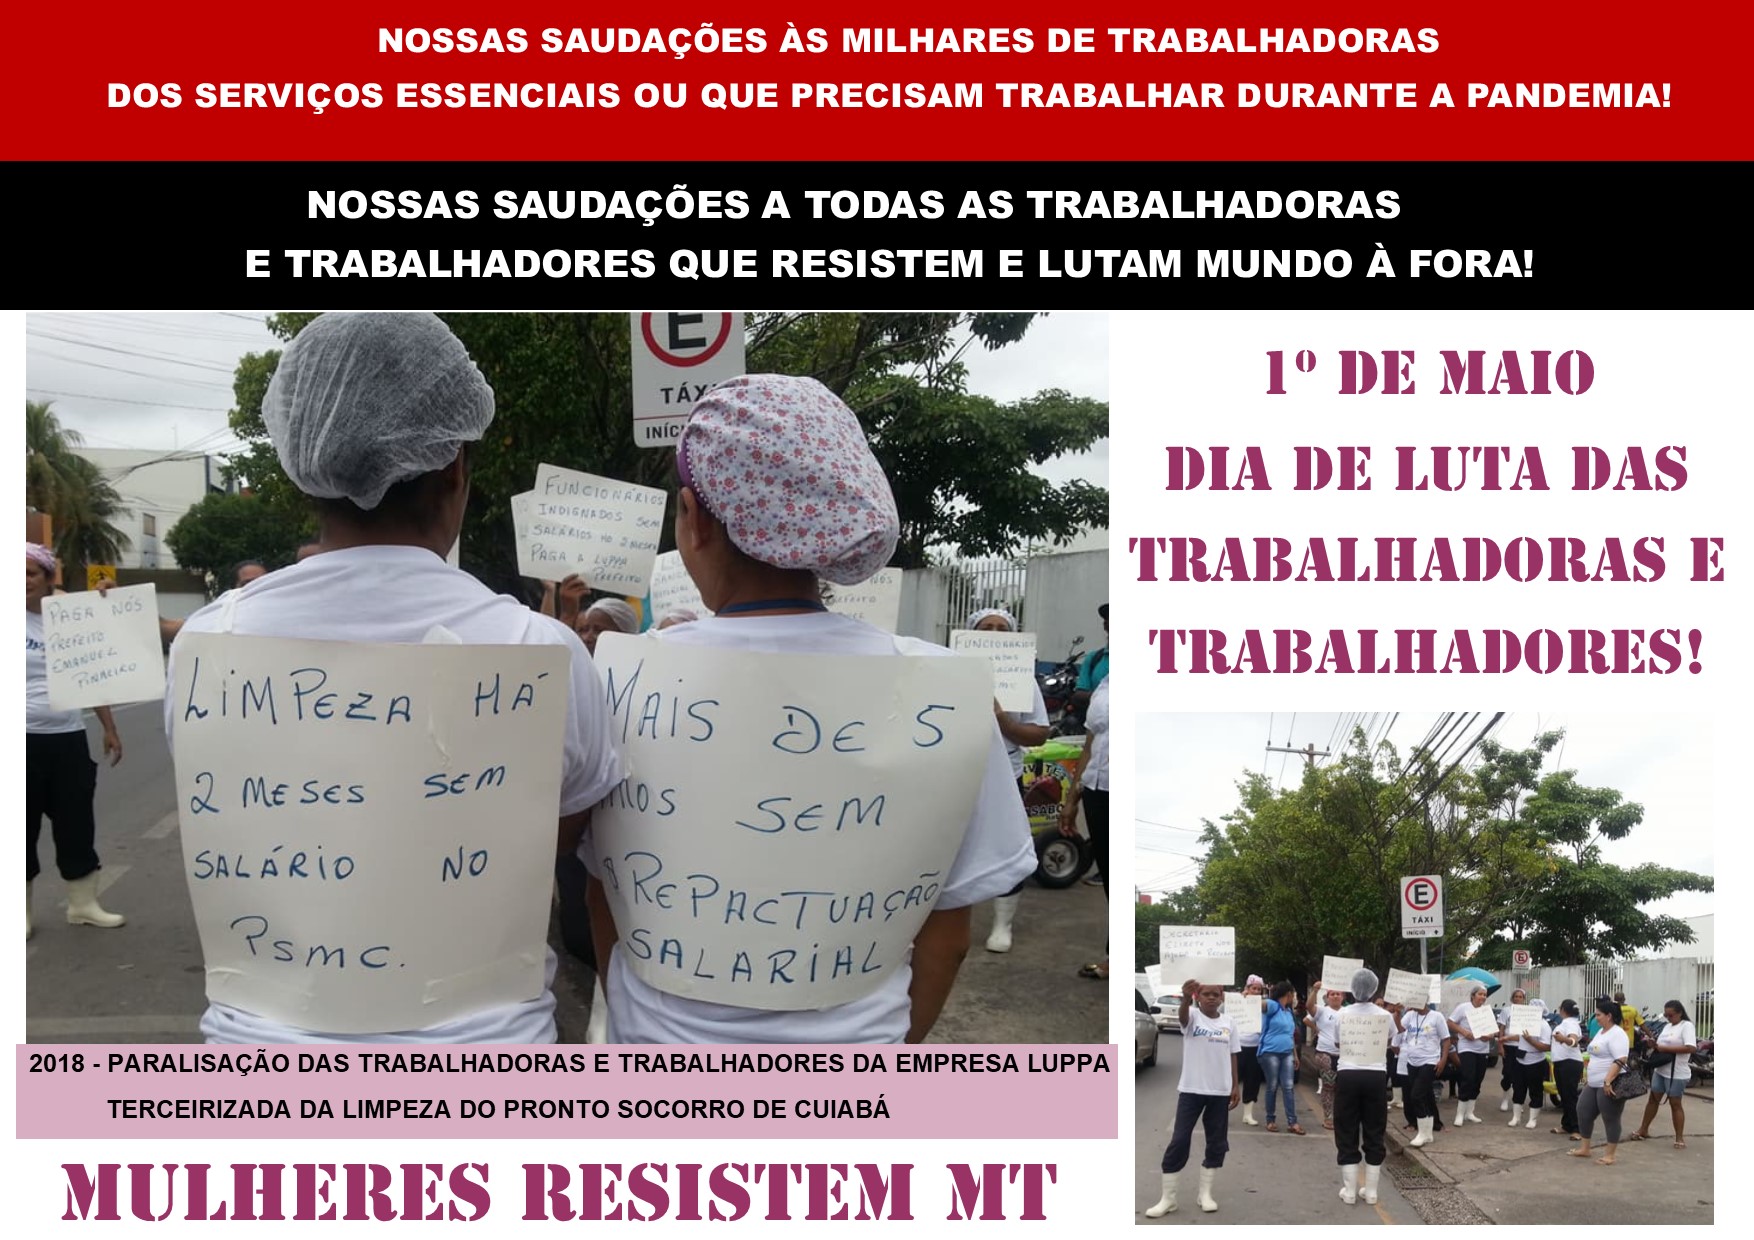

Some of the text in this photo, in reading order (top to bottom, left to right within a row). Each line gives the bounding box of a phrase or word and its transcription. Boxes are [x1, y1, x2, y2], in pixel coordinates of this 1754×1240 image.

[668, 312, 706, 350] E
[660, 381, 717, 404] TÁX
[646, 422, 685, 439] INÍC
[545, 474, 665, 506] FUNCIONÁRIOS
[538, 502, 623, 522] INDIGNADOS
[533, 524, 592, 540] SALÁRIOS
[531, 543, 567, 562] PAGA
[48, 595, 143, 626] PAGA NÓS
[48, 631, 104, 653] PREFEITO
[474, 672, 549, 718] HÁ
[605, 658, 720, 743] MAIS
[772, 704, 867, 755] DE
[190, 765, 506, 815] 2 MESES SEM
[736, 794, 887, 834] SEM
[193, 845, 489, 883] SALÁRIO NO
[623, 852, 943, 930] REPACTUAÇÃO
[1413, 884, 1428, 905] E
[1412, 916, 1434, 924] TÁXI
[626, 928, 883, 985] SALARIAL
[1518, 953, 1525, 962] E
